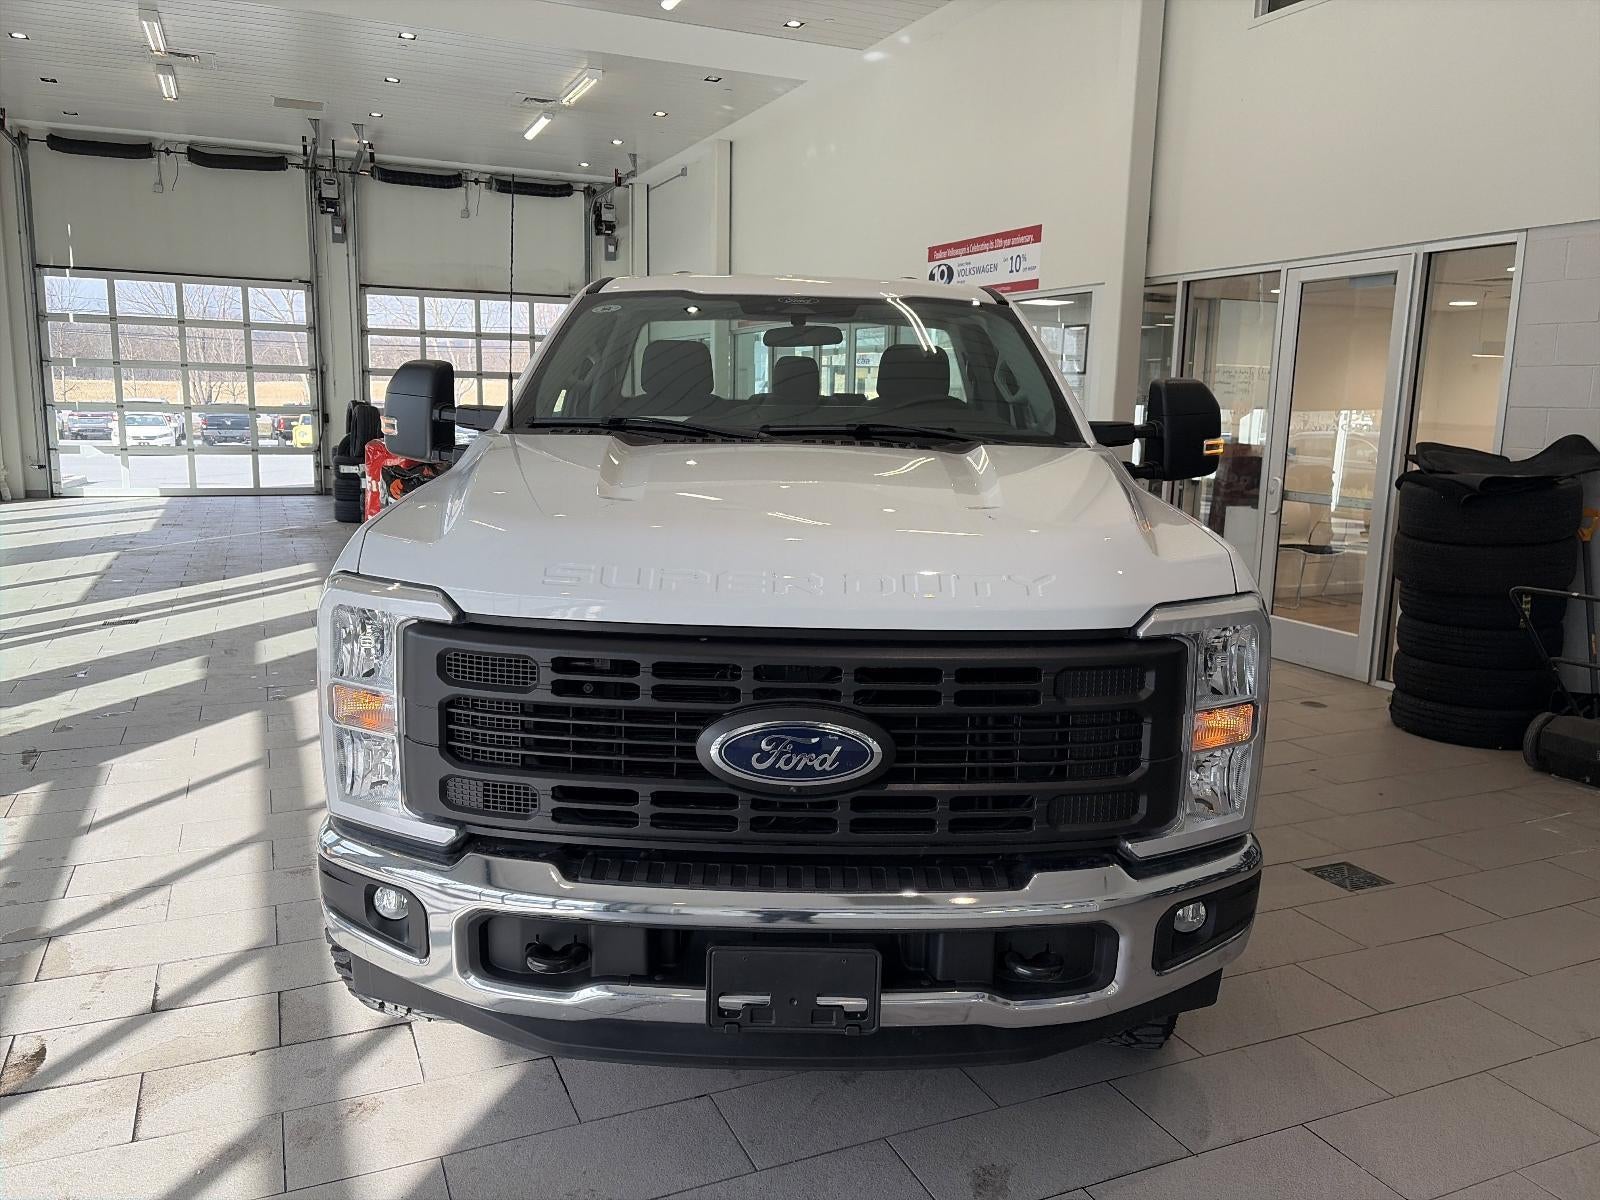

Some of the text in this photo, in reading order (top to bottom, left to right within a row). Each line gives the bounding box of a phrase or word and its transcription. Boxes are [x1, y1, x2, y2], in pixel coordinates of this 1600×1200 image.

[970, 240, 989, 252] Celebrating
[1003, 237, 1011, 248] year
[957, 263, 998, 278] VOLKSWAGEN
[541, 562, 1057, 599] SUPER DUTY
[751, 735, 842, 771] Ford
